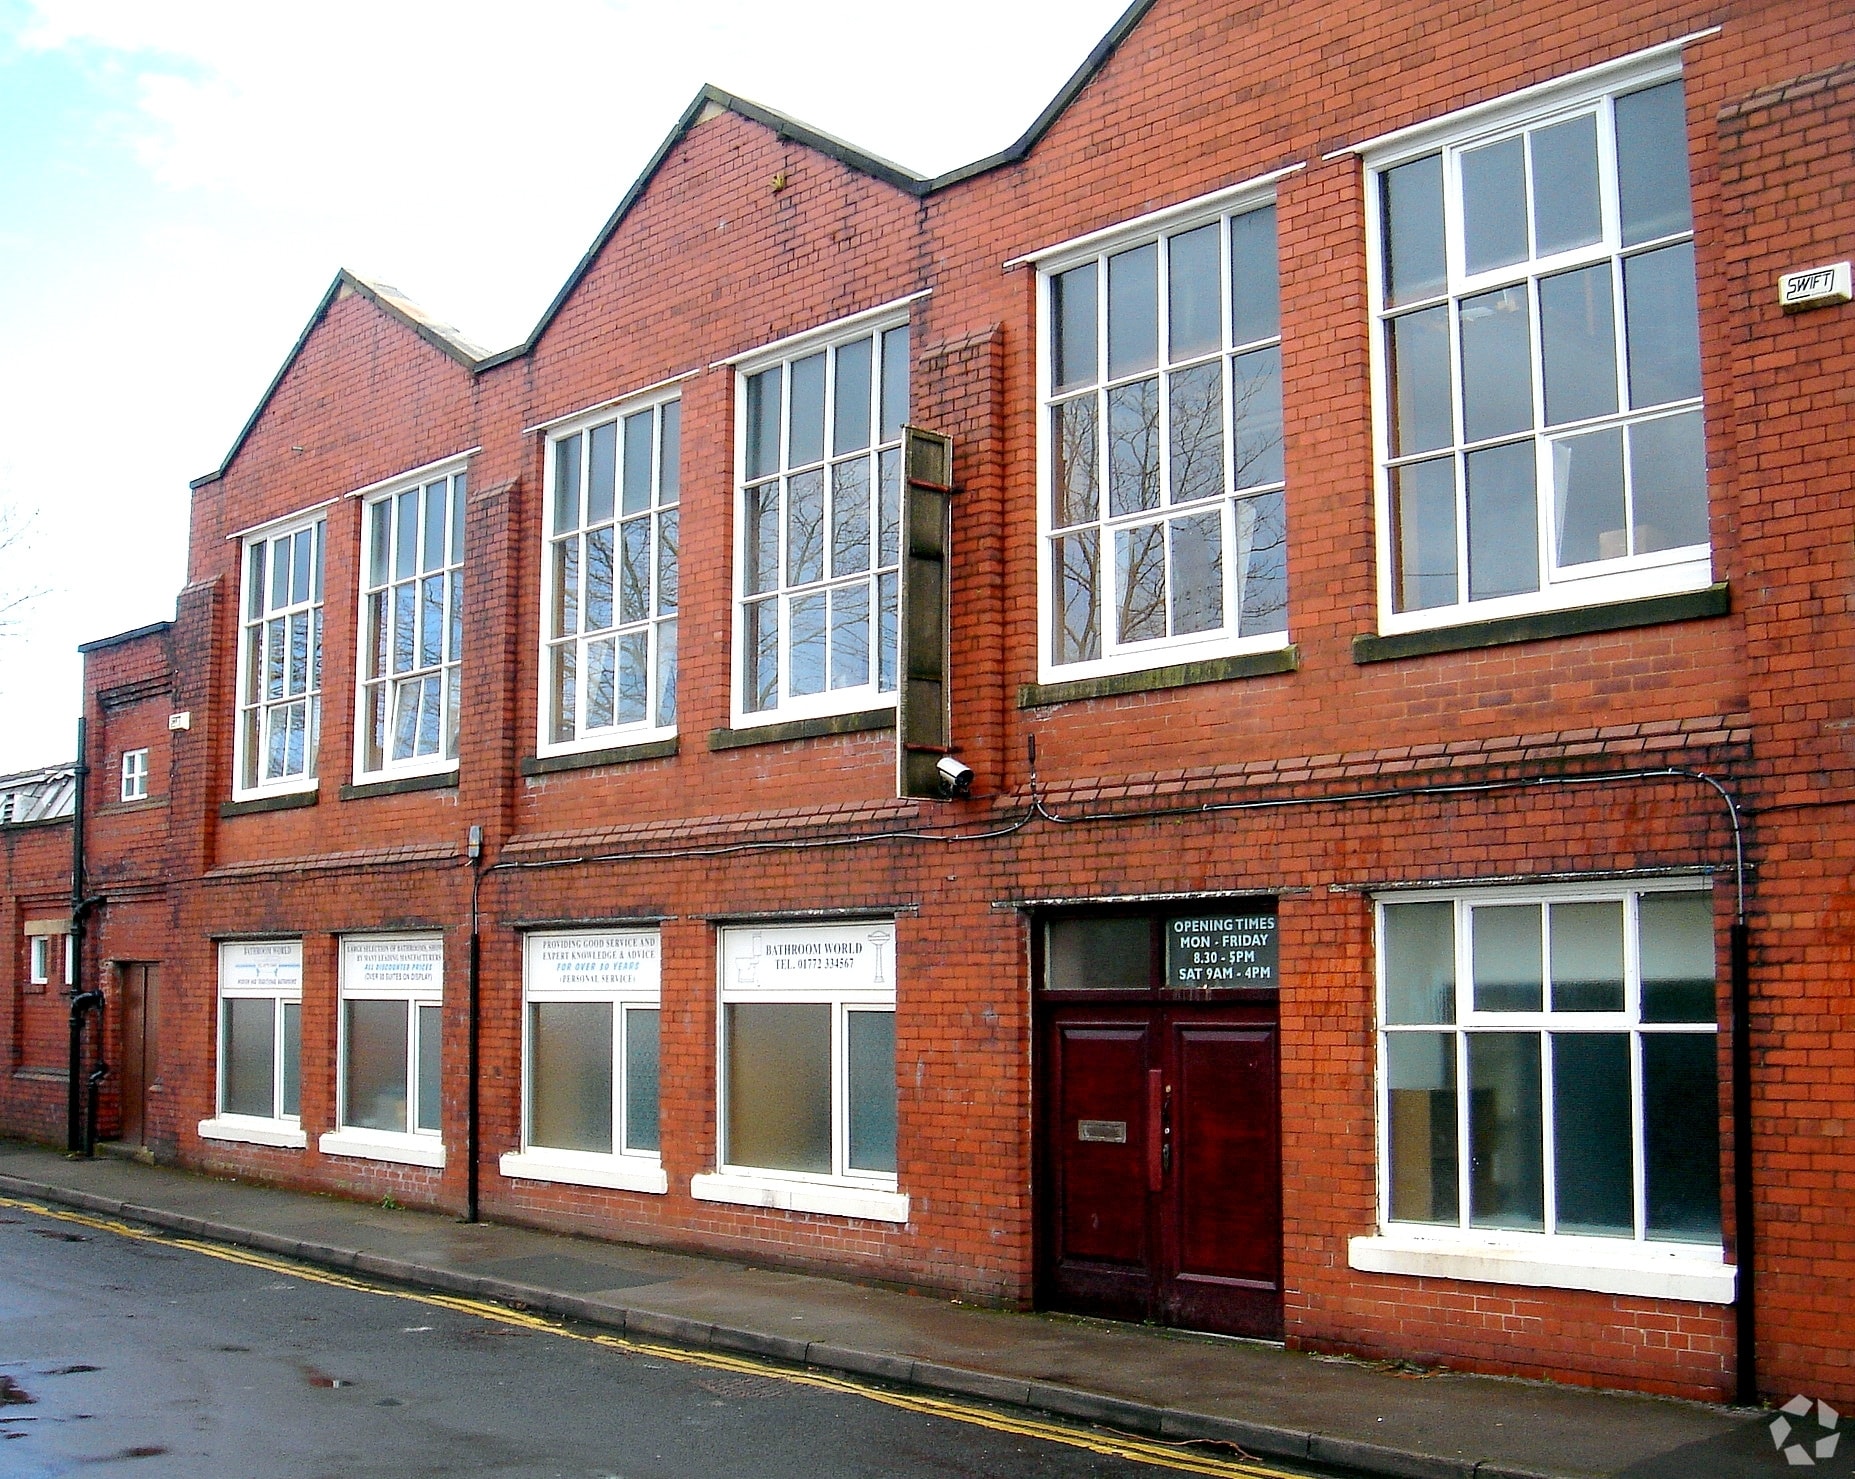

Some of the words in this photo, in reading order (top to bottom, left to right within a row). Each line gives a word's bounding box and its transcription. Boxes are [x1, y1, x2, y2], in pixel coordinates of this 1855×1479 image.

[1787, 270, 1834, 297] SWIFT
[1174, 919, 1233, 933] OPENING
[1235, 917, 1275, 931] TIMES
[542, 940, 581, 949] PROVIDING
[583, 939, 604, 948] GOOD
[606, 938, 638, 947] SERVICE
[640, 938, 656, 946] AND
[1180, 936, 1210, 949] MON
[1222, 933, 1269, 947] FRIDAY
[542, 952, 569, 960] EXPERT
[571, 951, 618, 960] KNOWLEDGE
[627, 950, 656, 959] ADVICE
[766, 943, 821, 956] BATHROOM
[824, 942, 863, 955] WORLD
[775, 959, 796, 970] TEL.
[797, 958, 822, 970] 01772
[824, 957, 854, 969] 334567
[1193, 951, 1218, 964] 8.30
[1229, 950, 1255, 963] 5PM
[364, 963, 375, 972] ALL
[376, 963, 411, 972] DISCOUNTED
[412, 963, 433, 972] PRICES
[556, 963, 573, 971] FOR
[575, 962, 597, 971] OVER
[613, 961, 640, 970] YEARS
[1179, 967, 1203, 980] SAT
[1206, 966, 1233, 980] 9AM
[1244, 966, 1271, 979] 4PM
